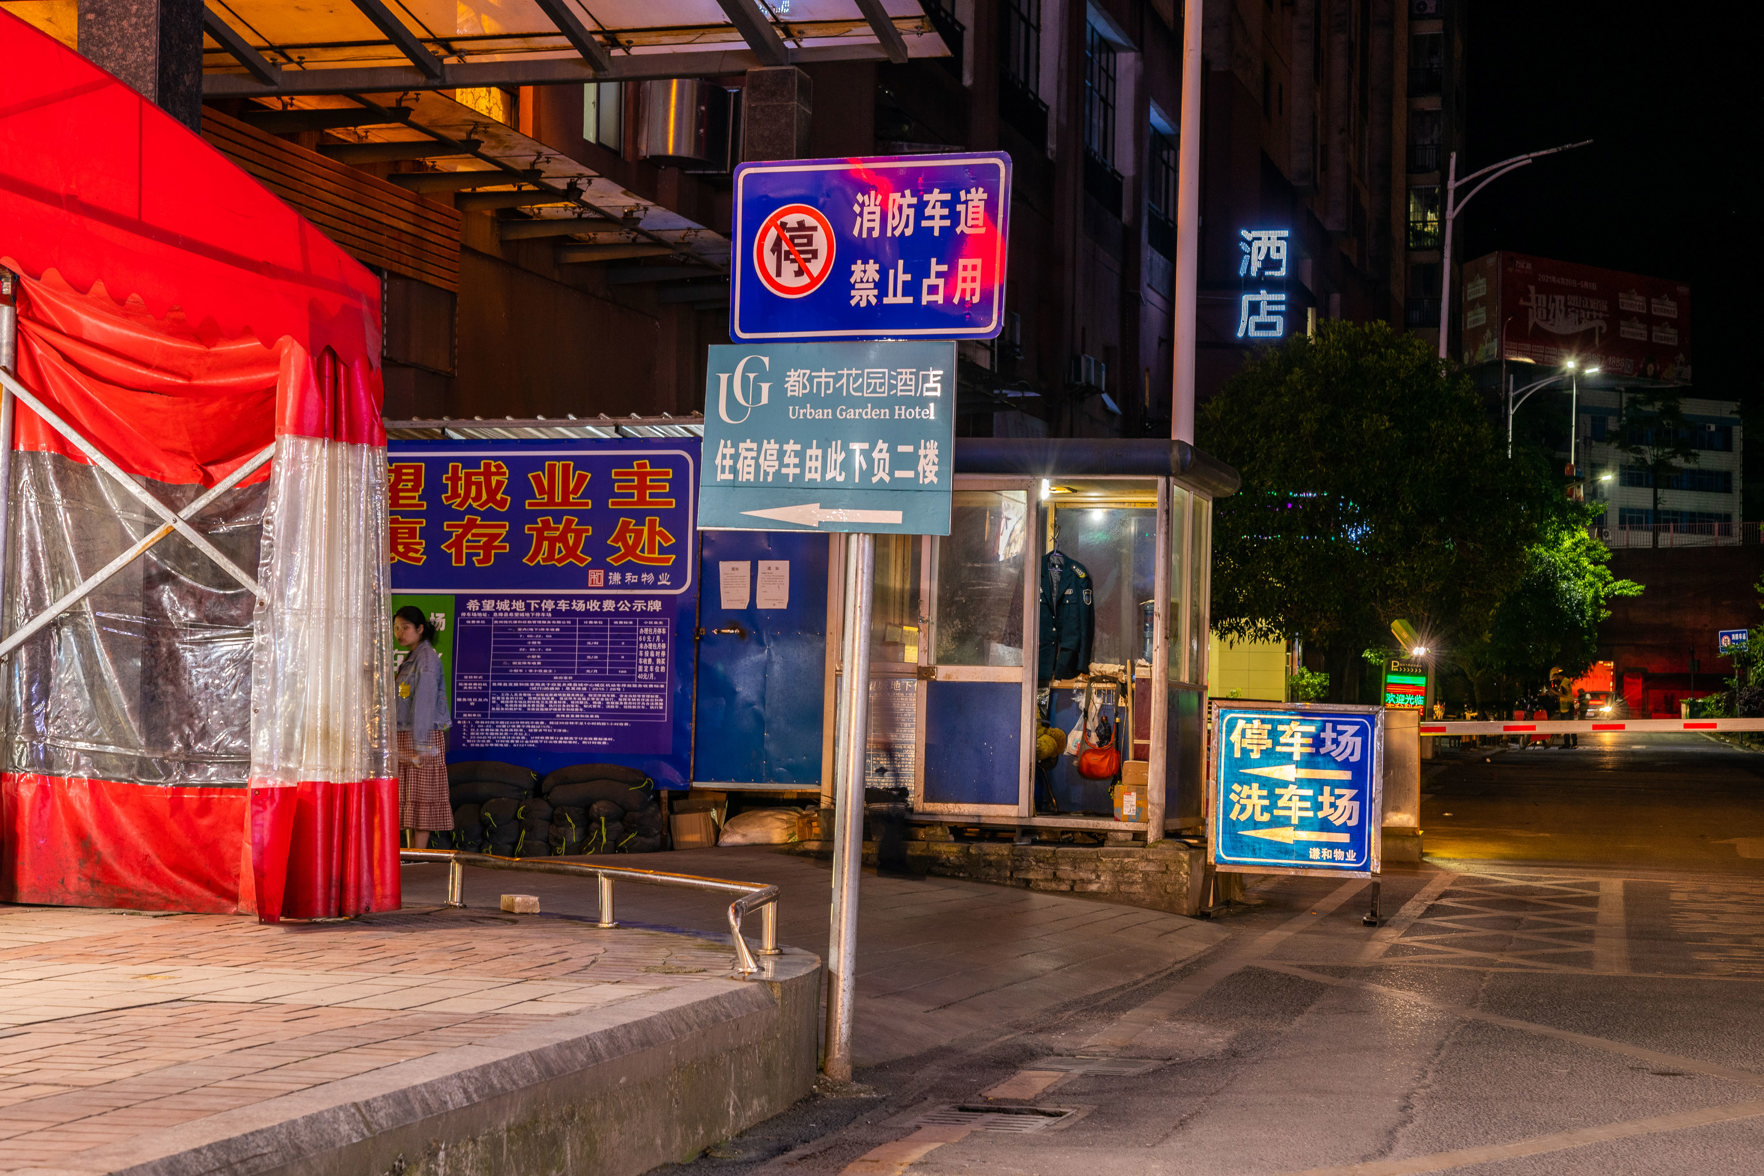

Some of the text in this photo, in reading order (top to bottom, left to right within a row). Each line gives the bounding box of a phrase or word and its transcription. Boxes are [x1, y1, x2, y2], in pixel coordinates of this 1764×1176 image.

[852, 187, 988, 239] 消防车道
[770, 219, 818, 278] 停
[850, 257, 982, 308] 禁止占用
[784, 367, 944, 398] 都市花园酒店
[788, 402, 936, 420] Urban Garden Hotel
[715, 438, 940, 485] 住宿停车由此下负二楼
[608, 571, 672, 586] 谦和物业
[466, 599, 663, 613] 希望城地下停车场收费公示牌
[1385, 692, 1425, 706] 欢迎光临
[1229, 719, 1363, 763] 停车场
[1229, 782, 1361, 827] 洗车场
[1308, 847, 1357, 862] 谦和物业
